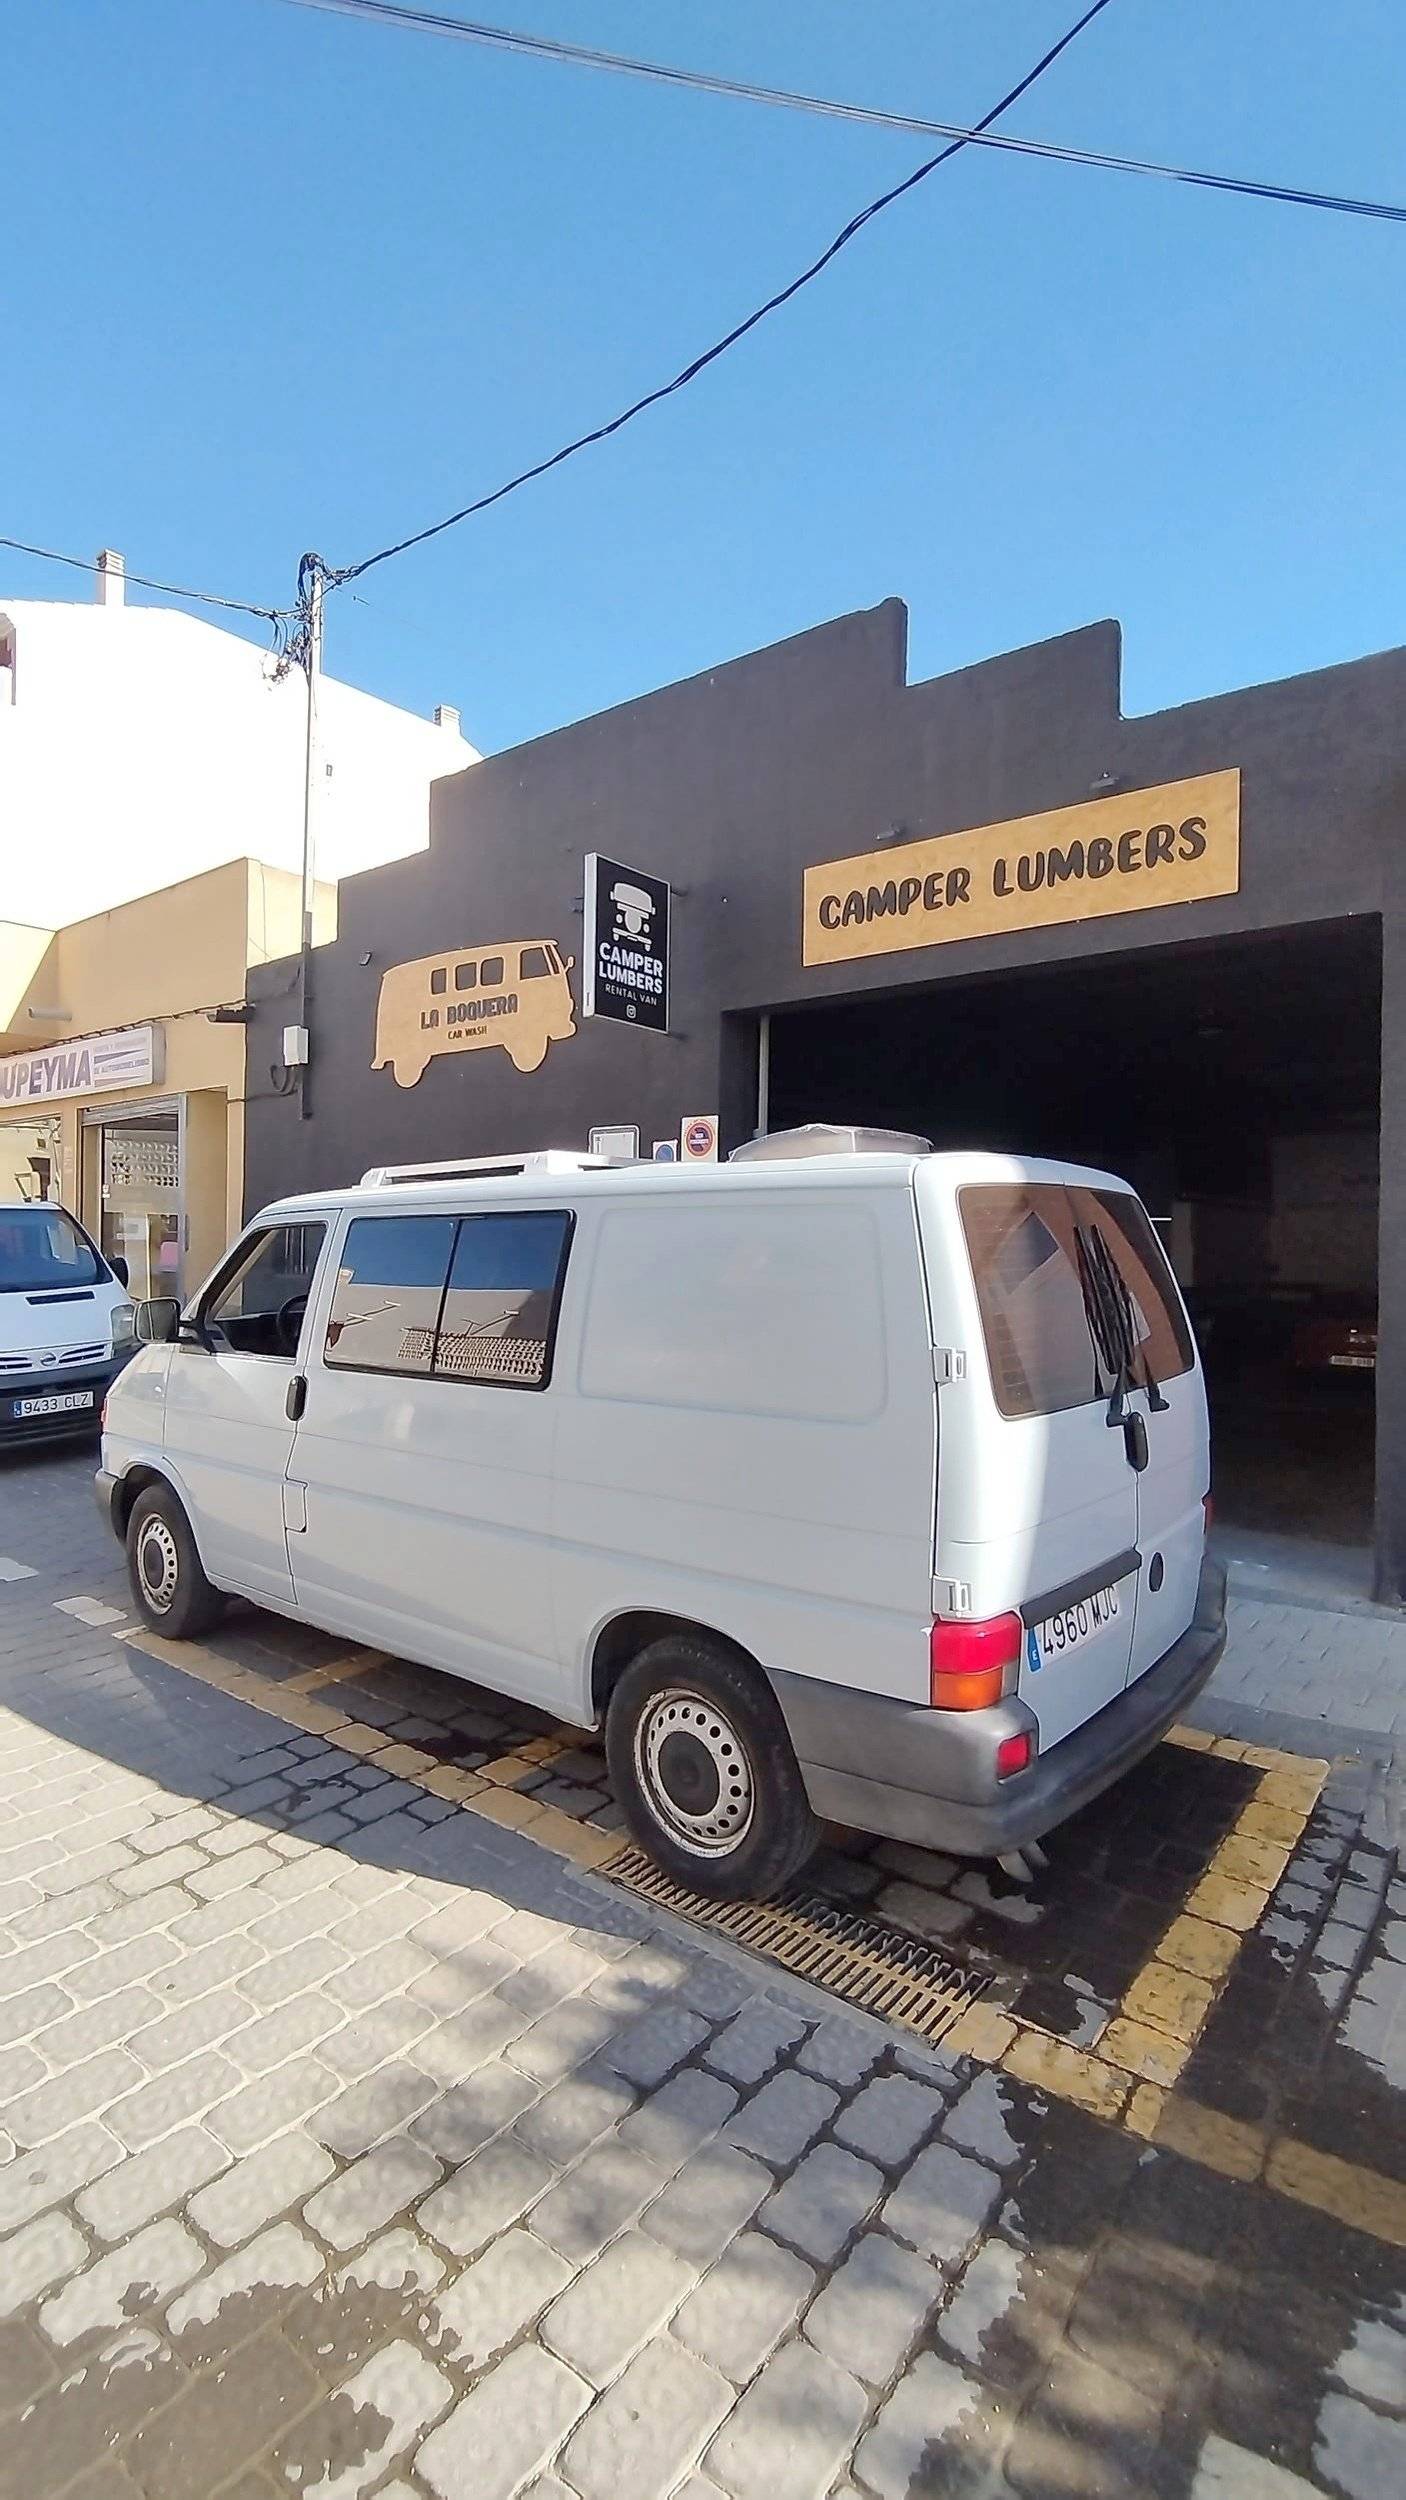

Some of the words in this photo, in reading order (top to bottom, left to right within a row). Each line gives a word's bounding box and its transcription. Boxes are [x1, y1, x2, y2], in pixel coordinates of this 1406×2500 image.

[819, 866, 971, 930] CAMPER
[993, 816, 1207, 898] LUMBERS
[599, 942, 663, 978] CAMPER
[598, 961, 663, 994] LUMBERS
[605, 983, 637, 1001] RENTAL
[640, 994, 657, 1006] VAN
[421, 1009, 439, 1030] LA
[447, 993, 518, 1025] BOQUERA
[448, 1030, 462, 1039] CAR
[465, 1026, 488, 1037] WASH
[24, 1398, 58, 1413] 9433
[64, 1394, 88, 1407] CLZ
[1043, 1603, 1088, 1654] 4960
[1090, 1585, 1118, 1628] MJC
[1031, 1649, 1038, 1661] E
